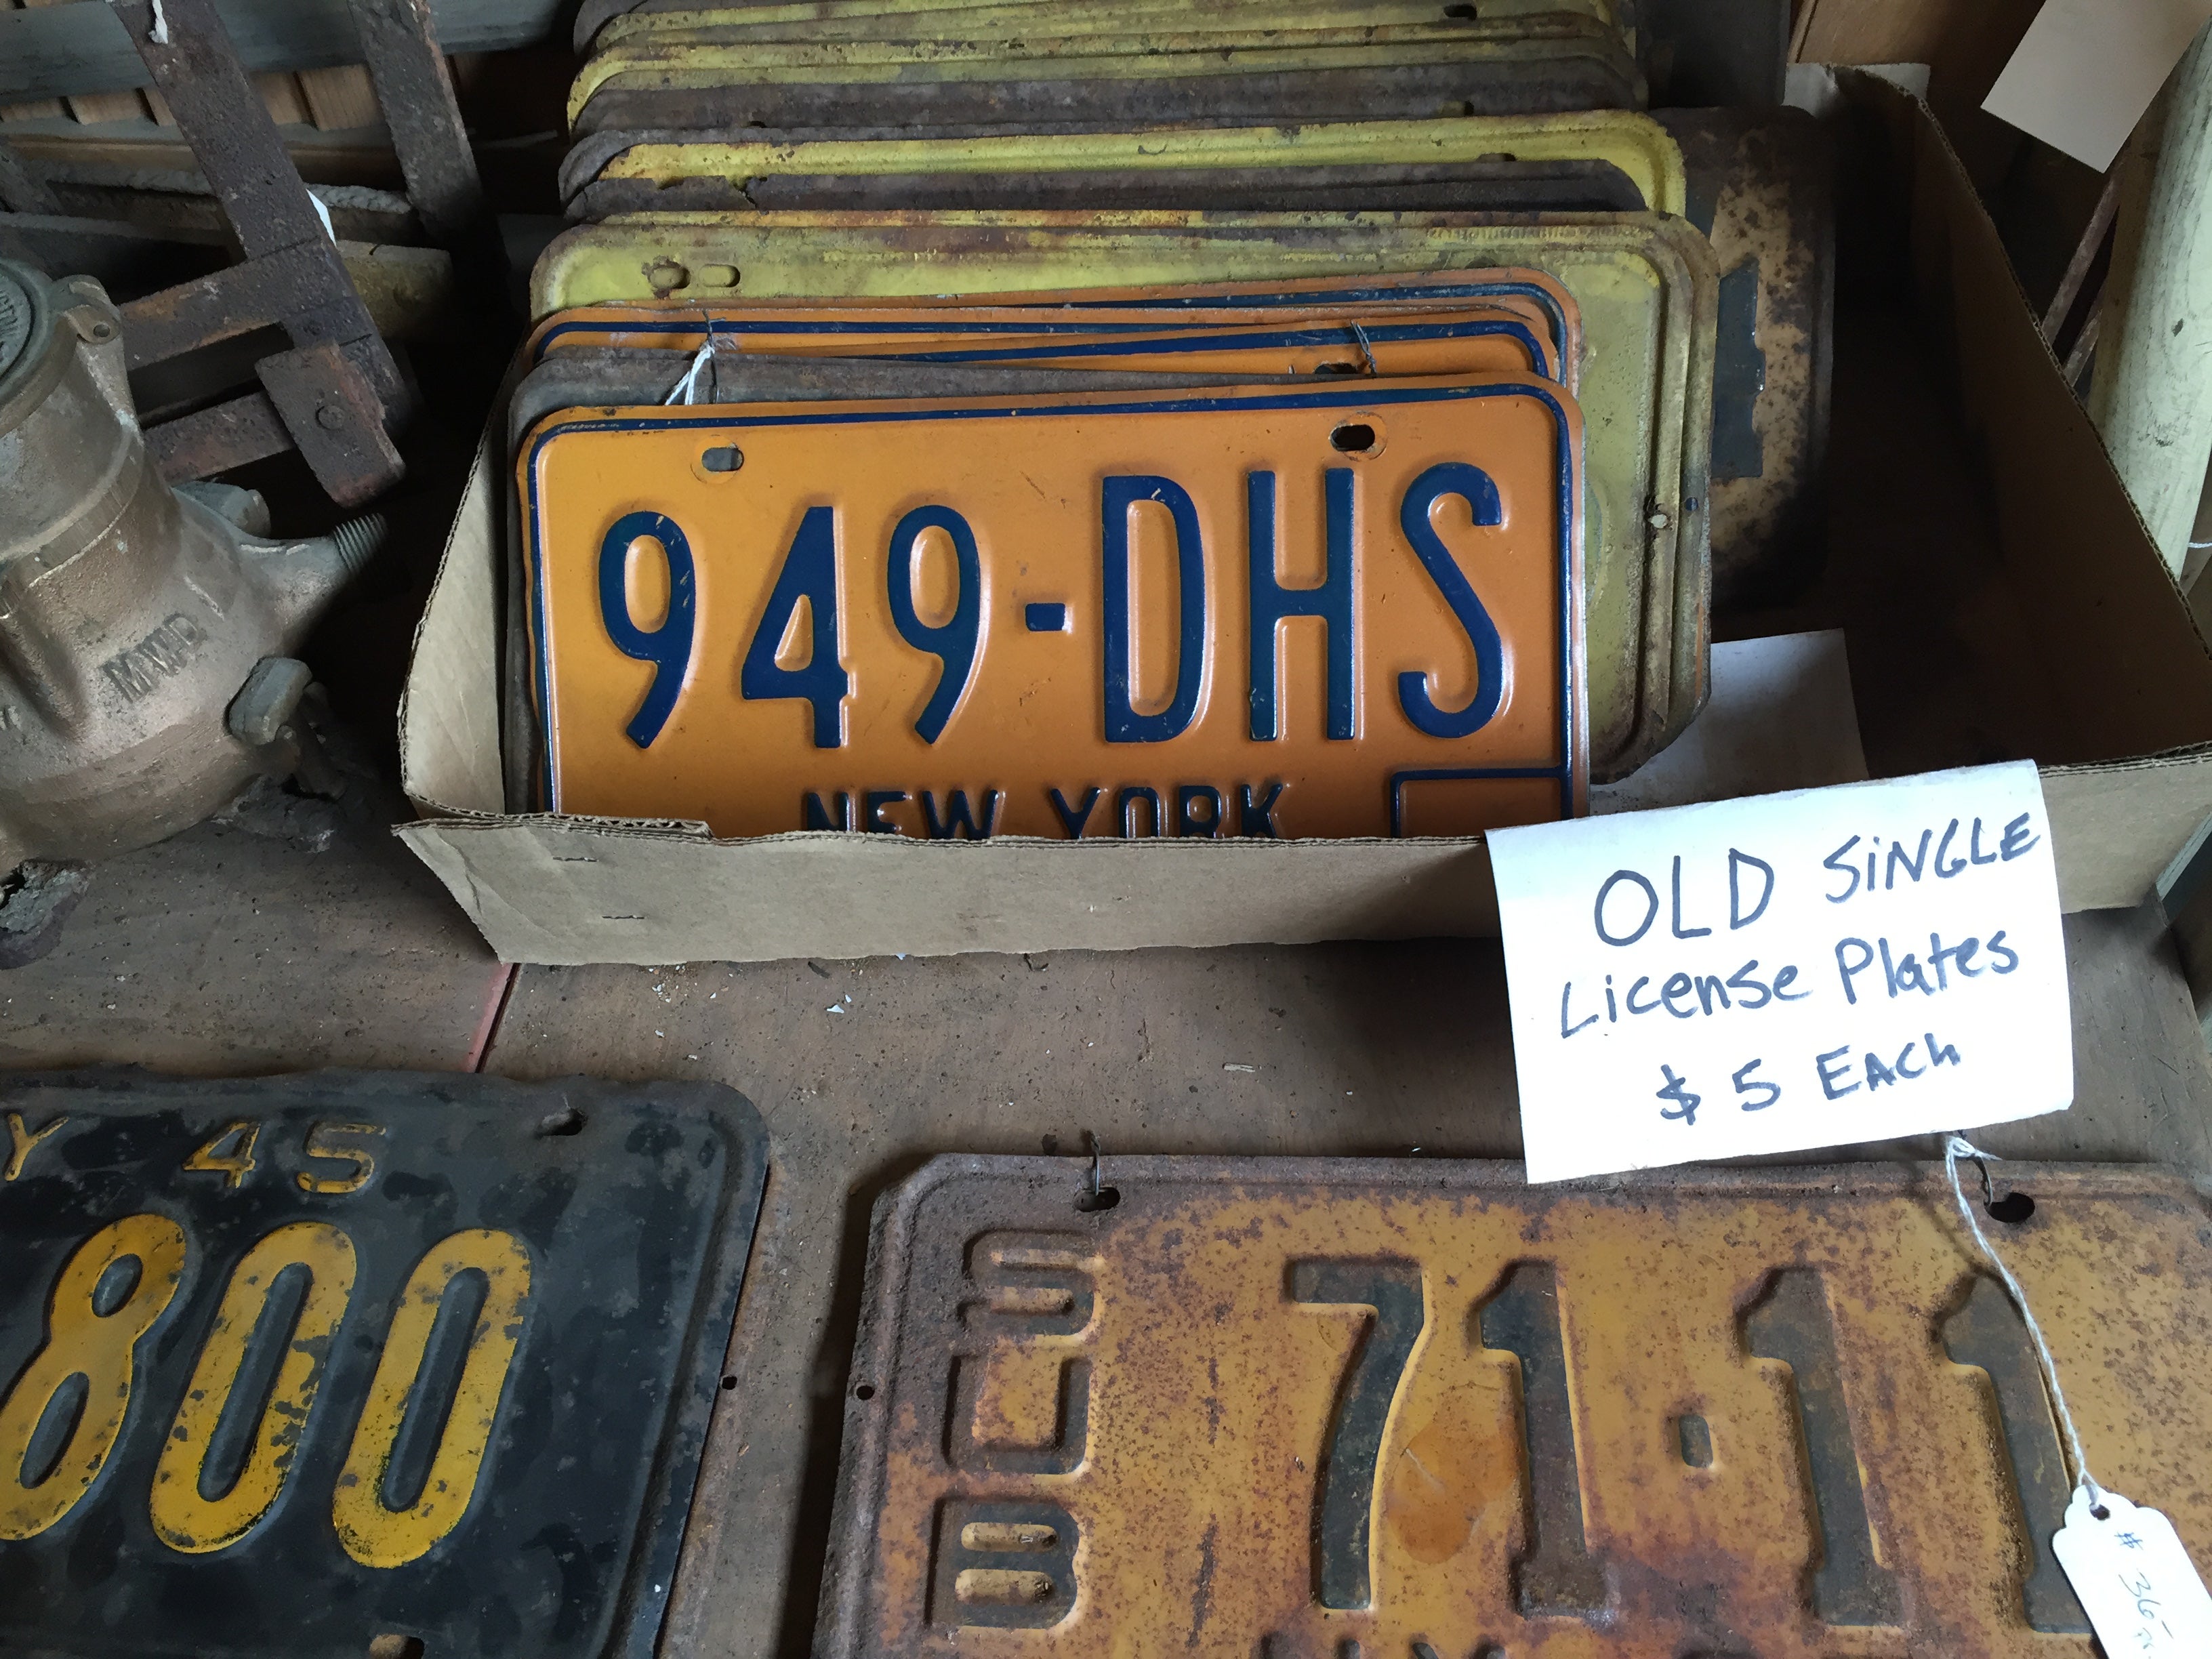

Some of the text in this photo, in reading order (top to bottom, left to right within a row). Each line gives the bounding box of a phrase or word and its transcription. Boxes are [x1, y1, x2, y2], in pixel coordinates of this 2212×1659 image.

[596, 462, 1504, 750] 949-DHS
[805, 783, 1285, 839] NEW YORK
[1593, 847, 1775, 947] OLD
[1560, 929, 2020, 1039] License Plates
[181, 1120, 388, 1195] 45
[0, 1212, 533, 1570] 800
